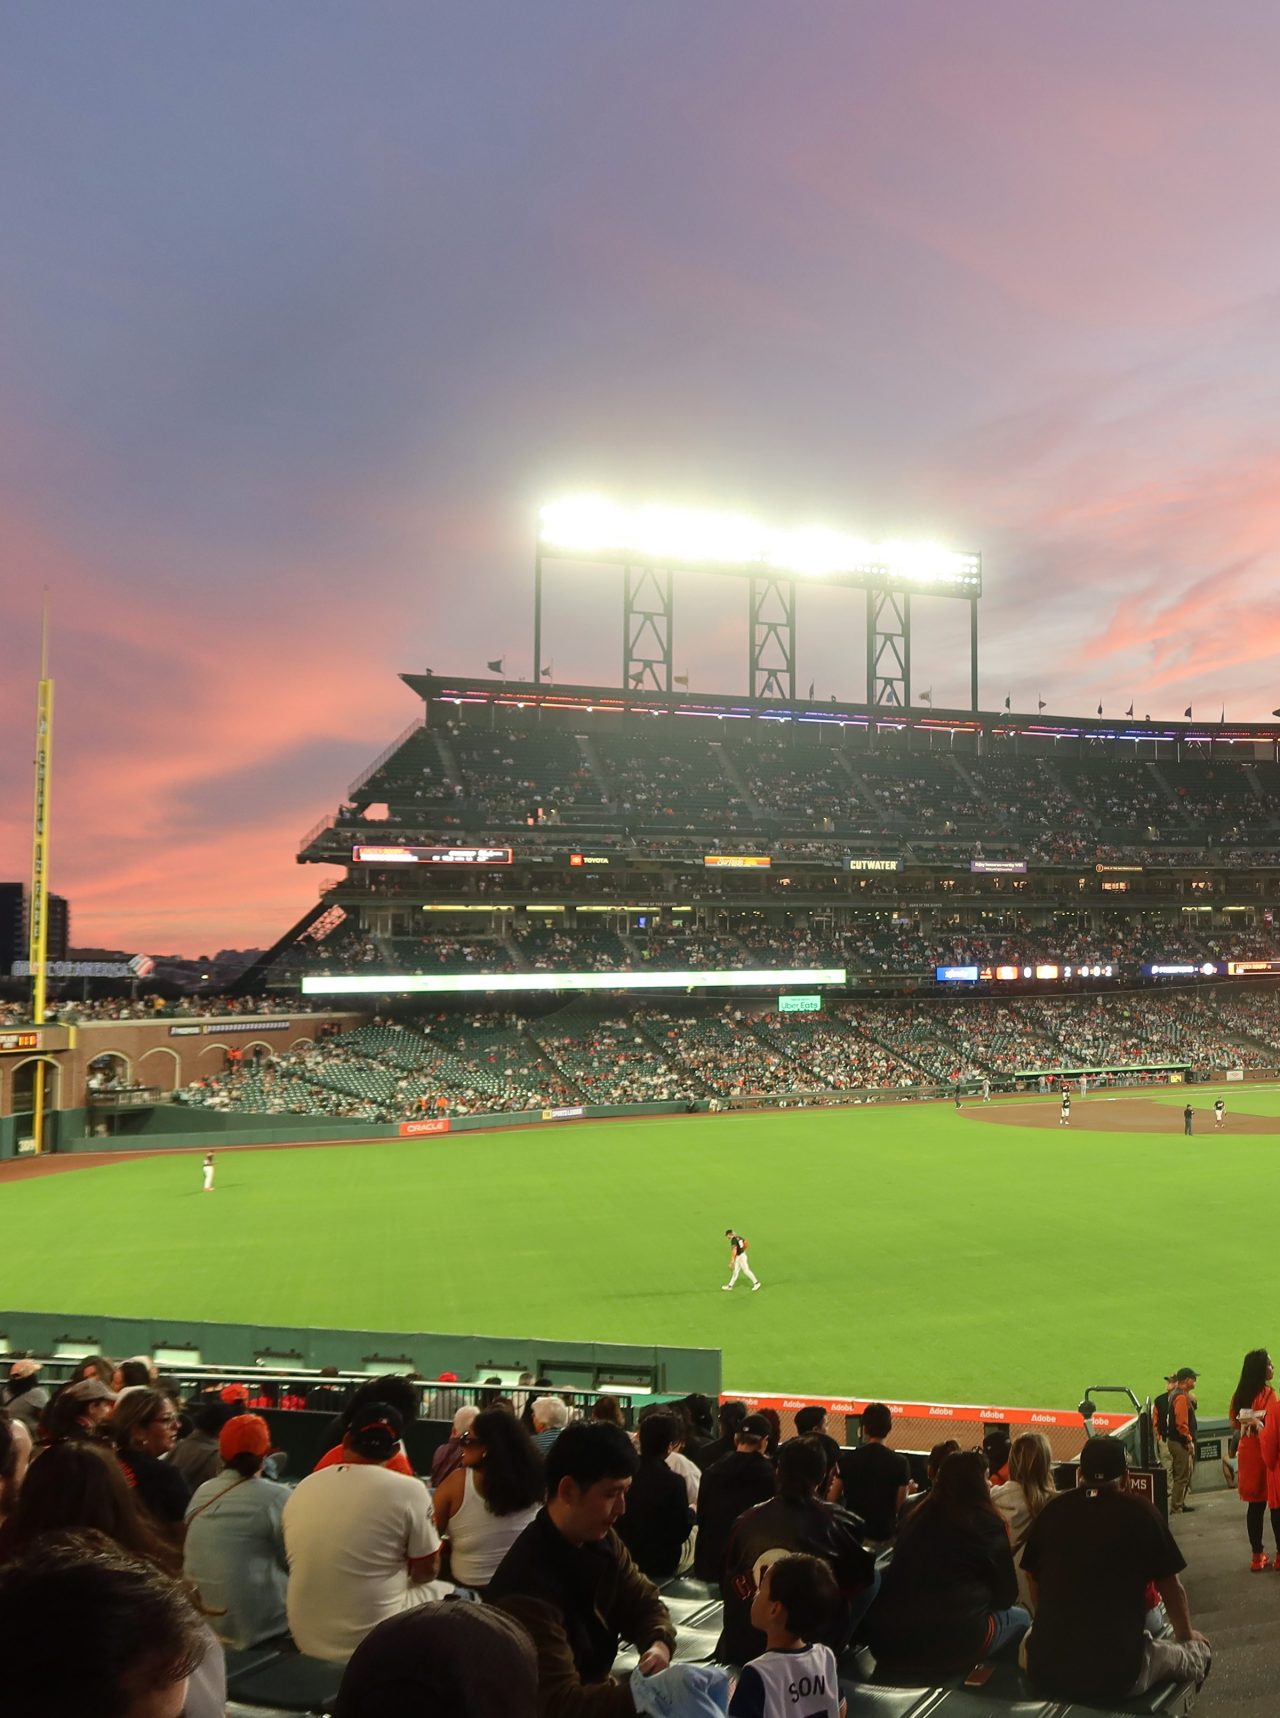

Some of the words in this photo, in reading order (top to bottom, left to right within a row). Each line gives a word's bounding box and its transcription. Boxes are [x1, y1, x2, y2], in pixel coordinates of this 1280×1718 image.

[850, 860, 896, 870] CUTWATER
[1064, 966, 1072, 978] 2
[800, 1001, 818, 1009] Eats
[406, 1121, 444, 1132] ORACLE
[831, 1403, 854, 1412] Adobe
[929, 1407, 953, 1415] Adobe
[980, 1410, 1004, 1419] Adobe
[1031, 1414, 1056, 1423] Adobe
[789, 1675, 825, 1703] SON
